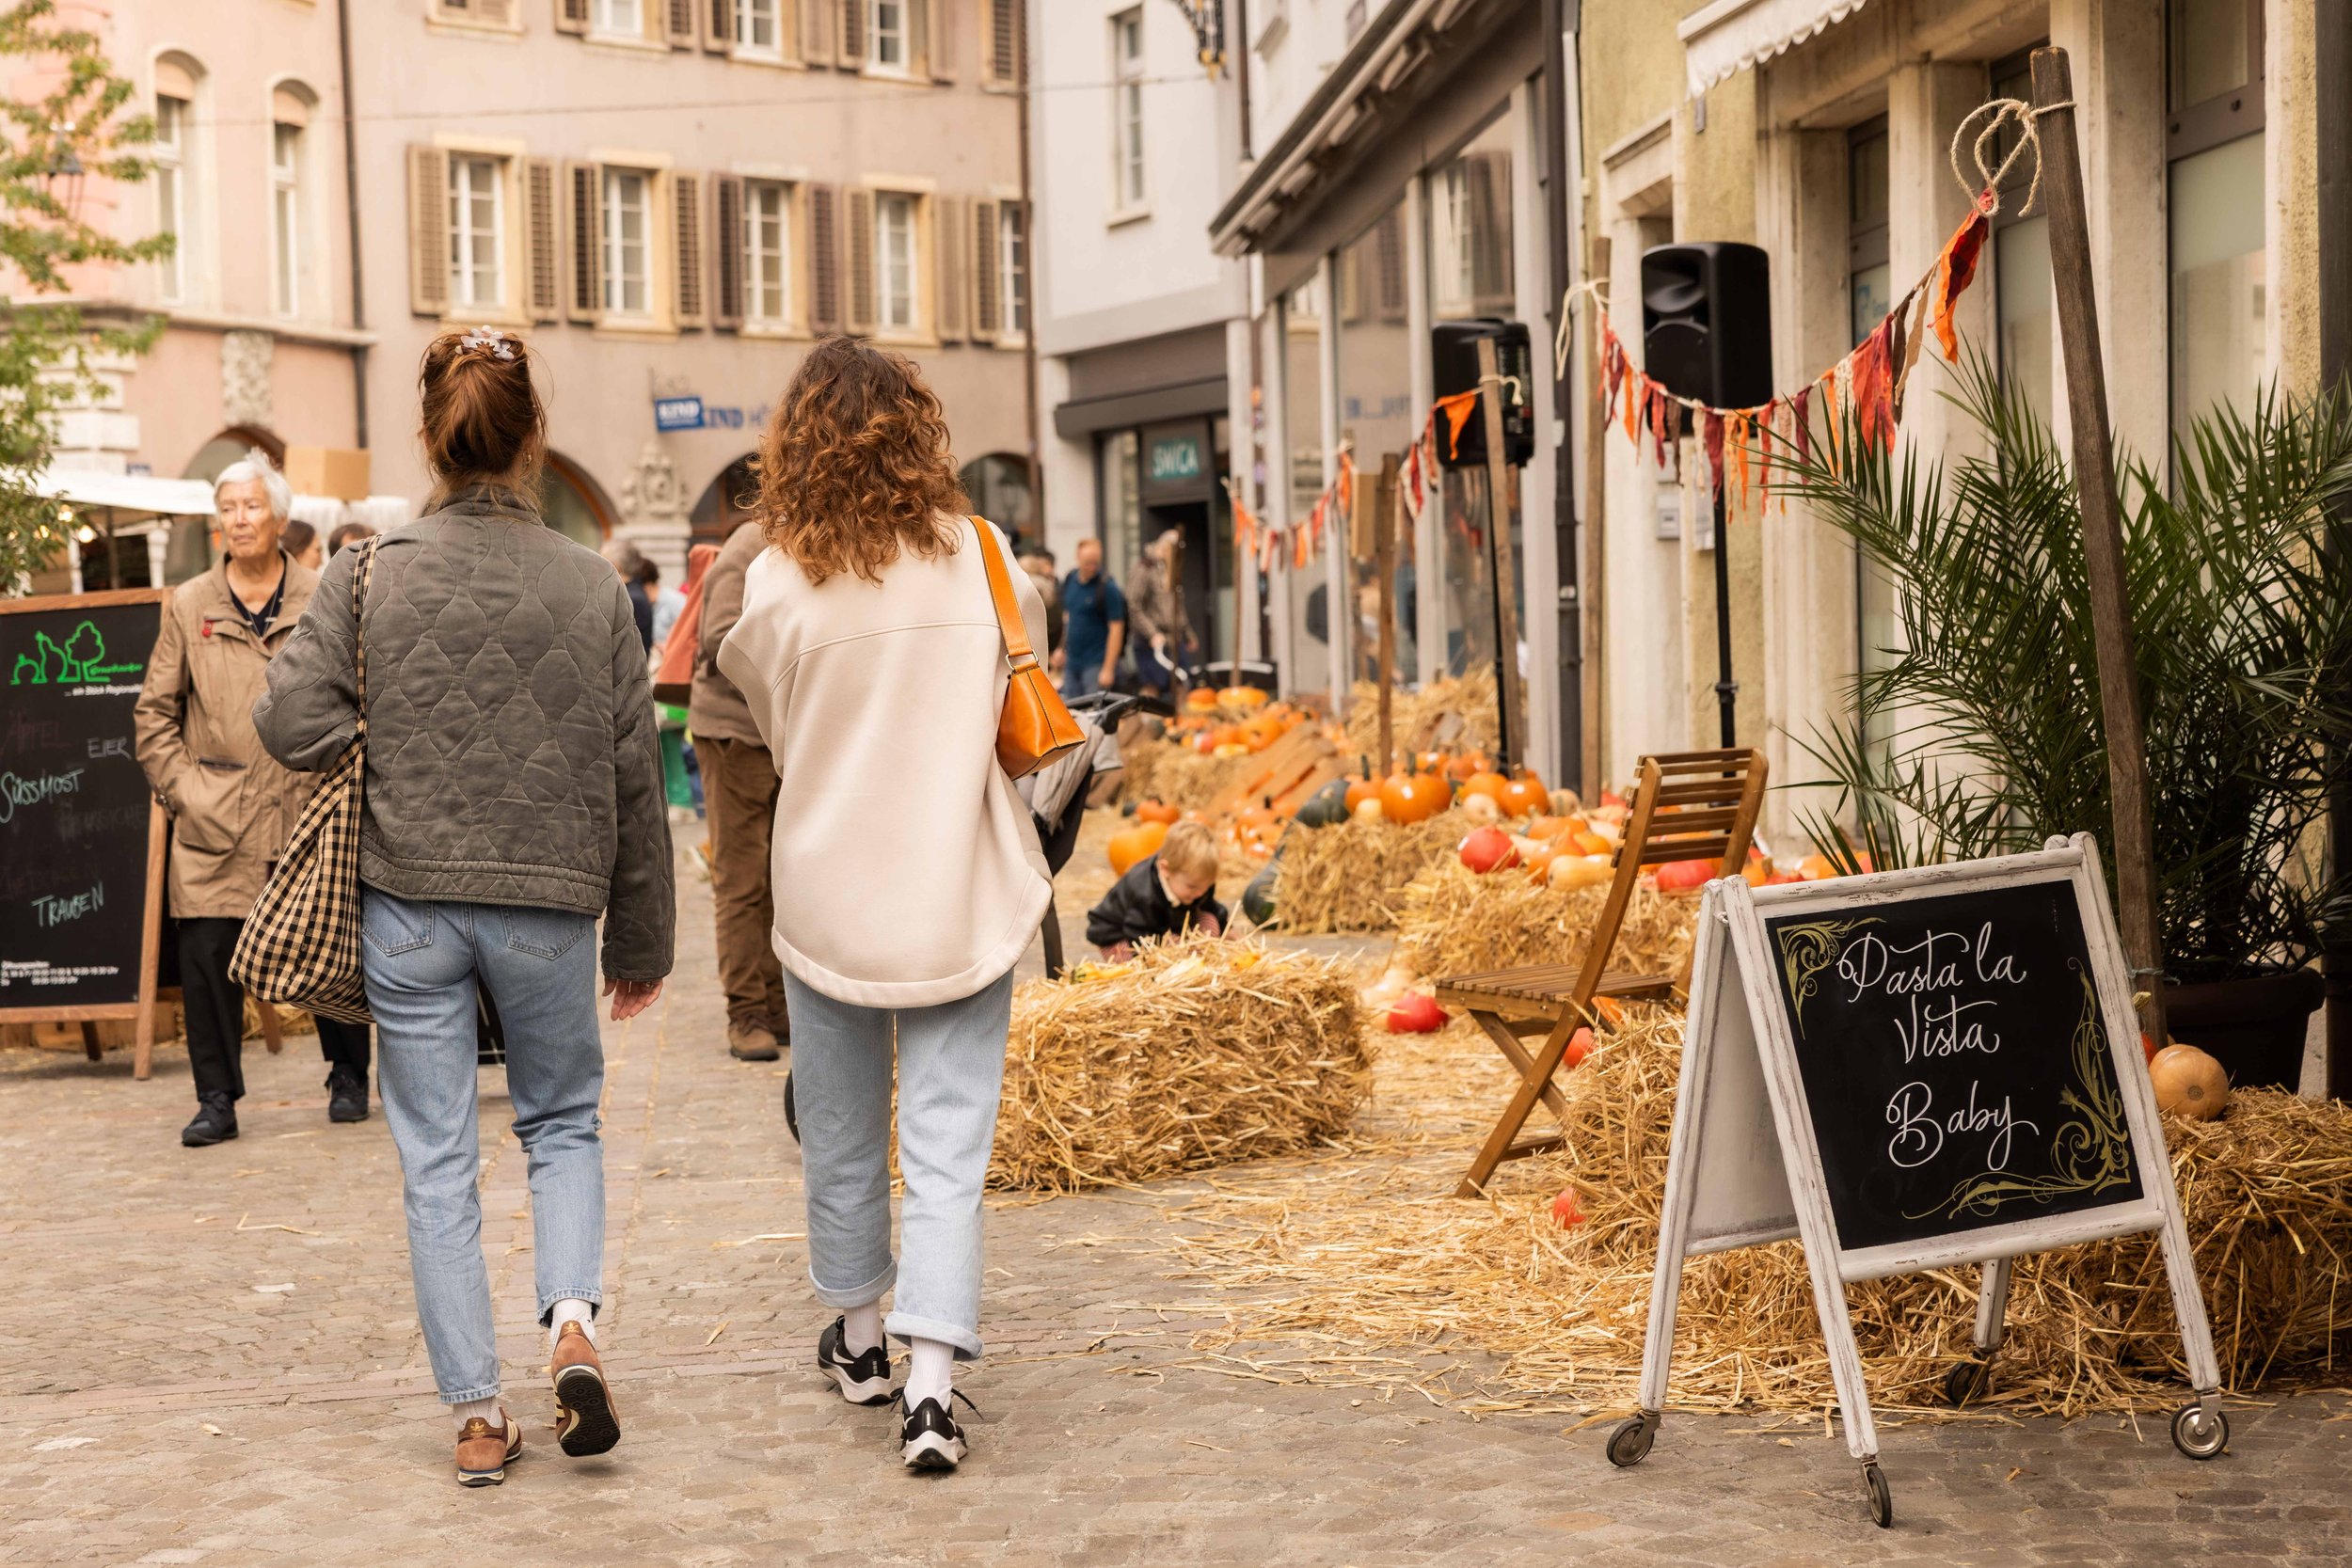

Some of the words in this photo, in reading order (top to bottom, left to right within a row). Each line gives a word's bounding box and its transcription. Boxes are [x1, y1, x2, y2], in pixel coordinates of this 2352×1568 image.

[707, 407, 744, 428] IND
[1152, 442, 1199, 477] SWICA
[87, 735, 132, 761] EIER
[31, 880, 104, 928] TRAUBEN
[1836, 929, 1969, 1003] Pasta
[1977, 921, 2026, 984] la
[1894, 993, 2000, 1064] Vista
[1885, 1080, 2040, 1171] Baby
